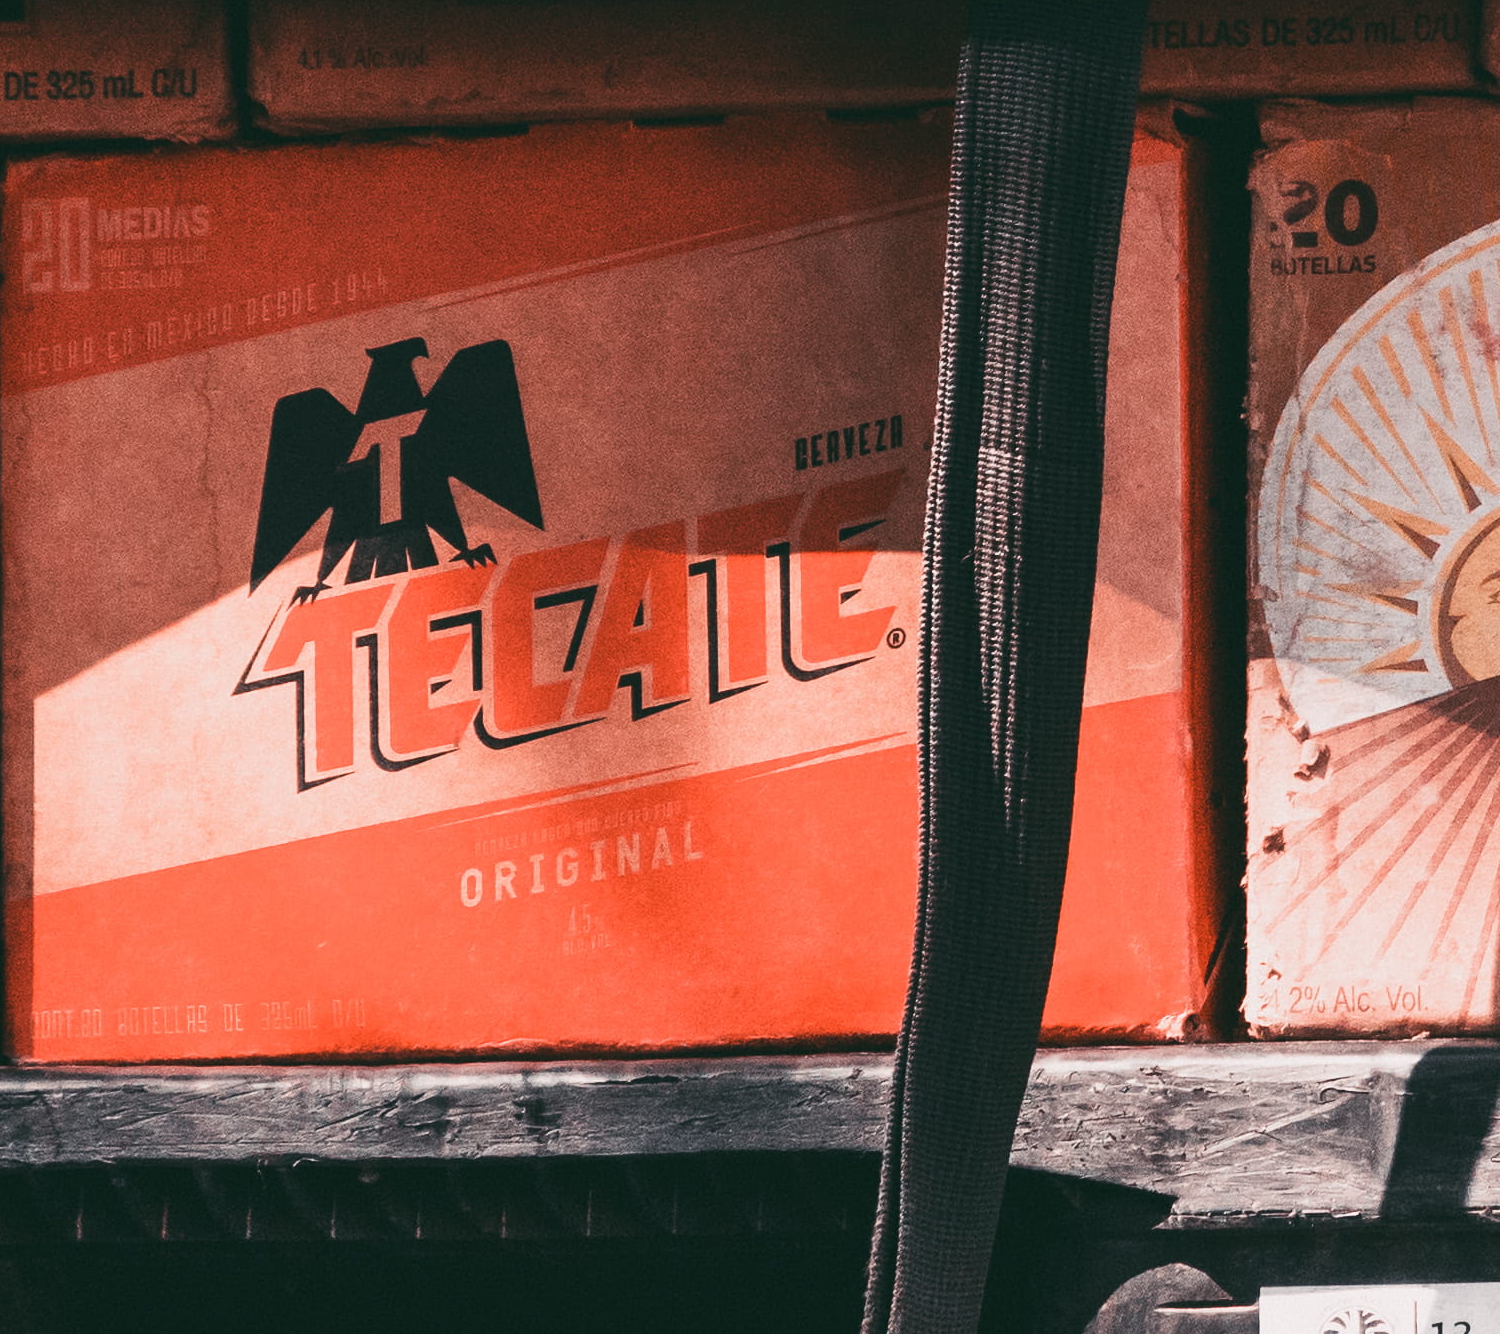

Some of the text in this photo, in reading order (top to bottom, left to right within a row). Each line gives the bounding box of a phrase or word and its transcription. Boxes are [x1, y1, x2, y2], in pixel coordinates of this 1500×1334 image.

[1261, 17, 1297, 47] DE
[1305, 17, 1354, 47] 325
[1364, 16, 1406, 45] mL
[1414, 13, 1462, 43] C/U
[4, 70, 39, 103] DE
[46, 69, 95, 101] 325
[103, 68, 143, 100] mL
[151, 66, 199, 99] C/U
[1269, 178, 1379, 248] 20
[22, 196, 90, 293] 20
[96, 203, 211, 242] MEDIAS
[1270, 253, 1378, 276] BOTELLAS
[793, 414, 904, 472] CERVEZA
[231, 469, 910, 794] TECATE
[460, 820, 704, 908] ORIGINAL
[117, 1003, 208, 1036] BOTELLAS
[223, 1002, 245, 1033] DE
[1332, 985, 1377, 1014] Alc.
[1385, 984, 1430, 1012] Vol.
